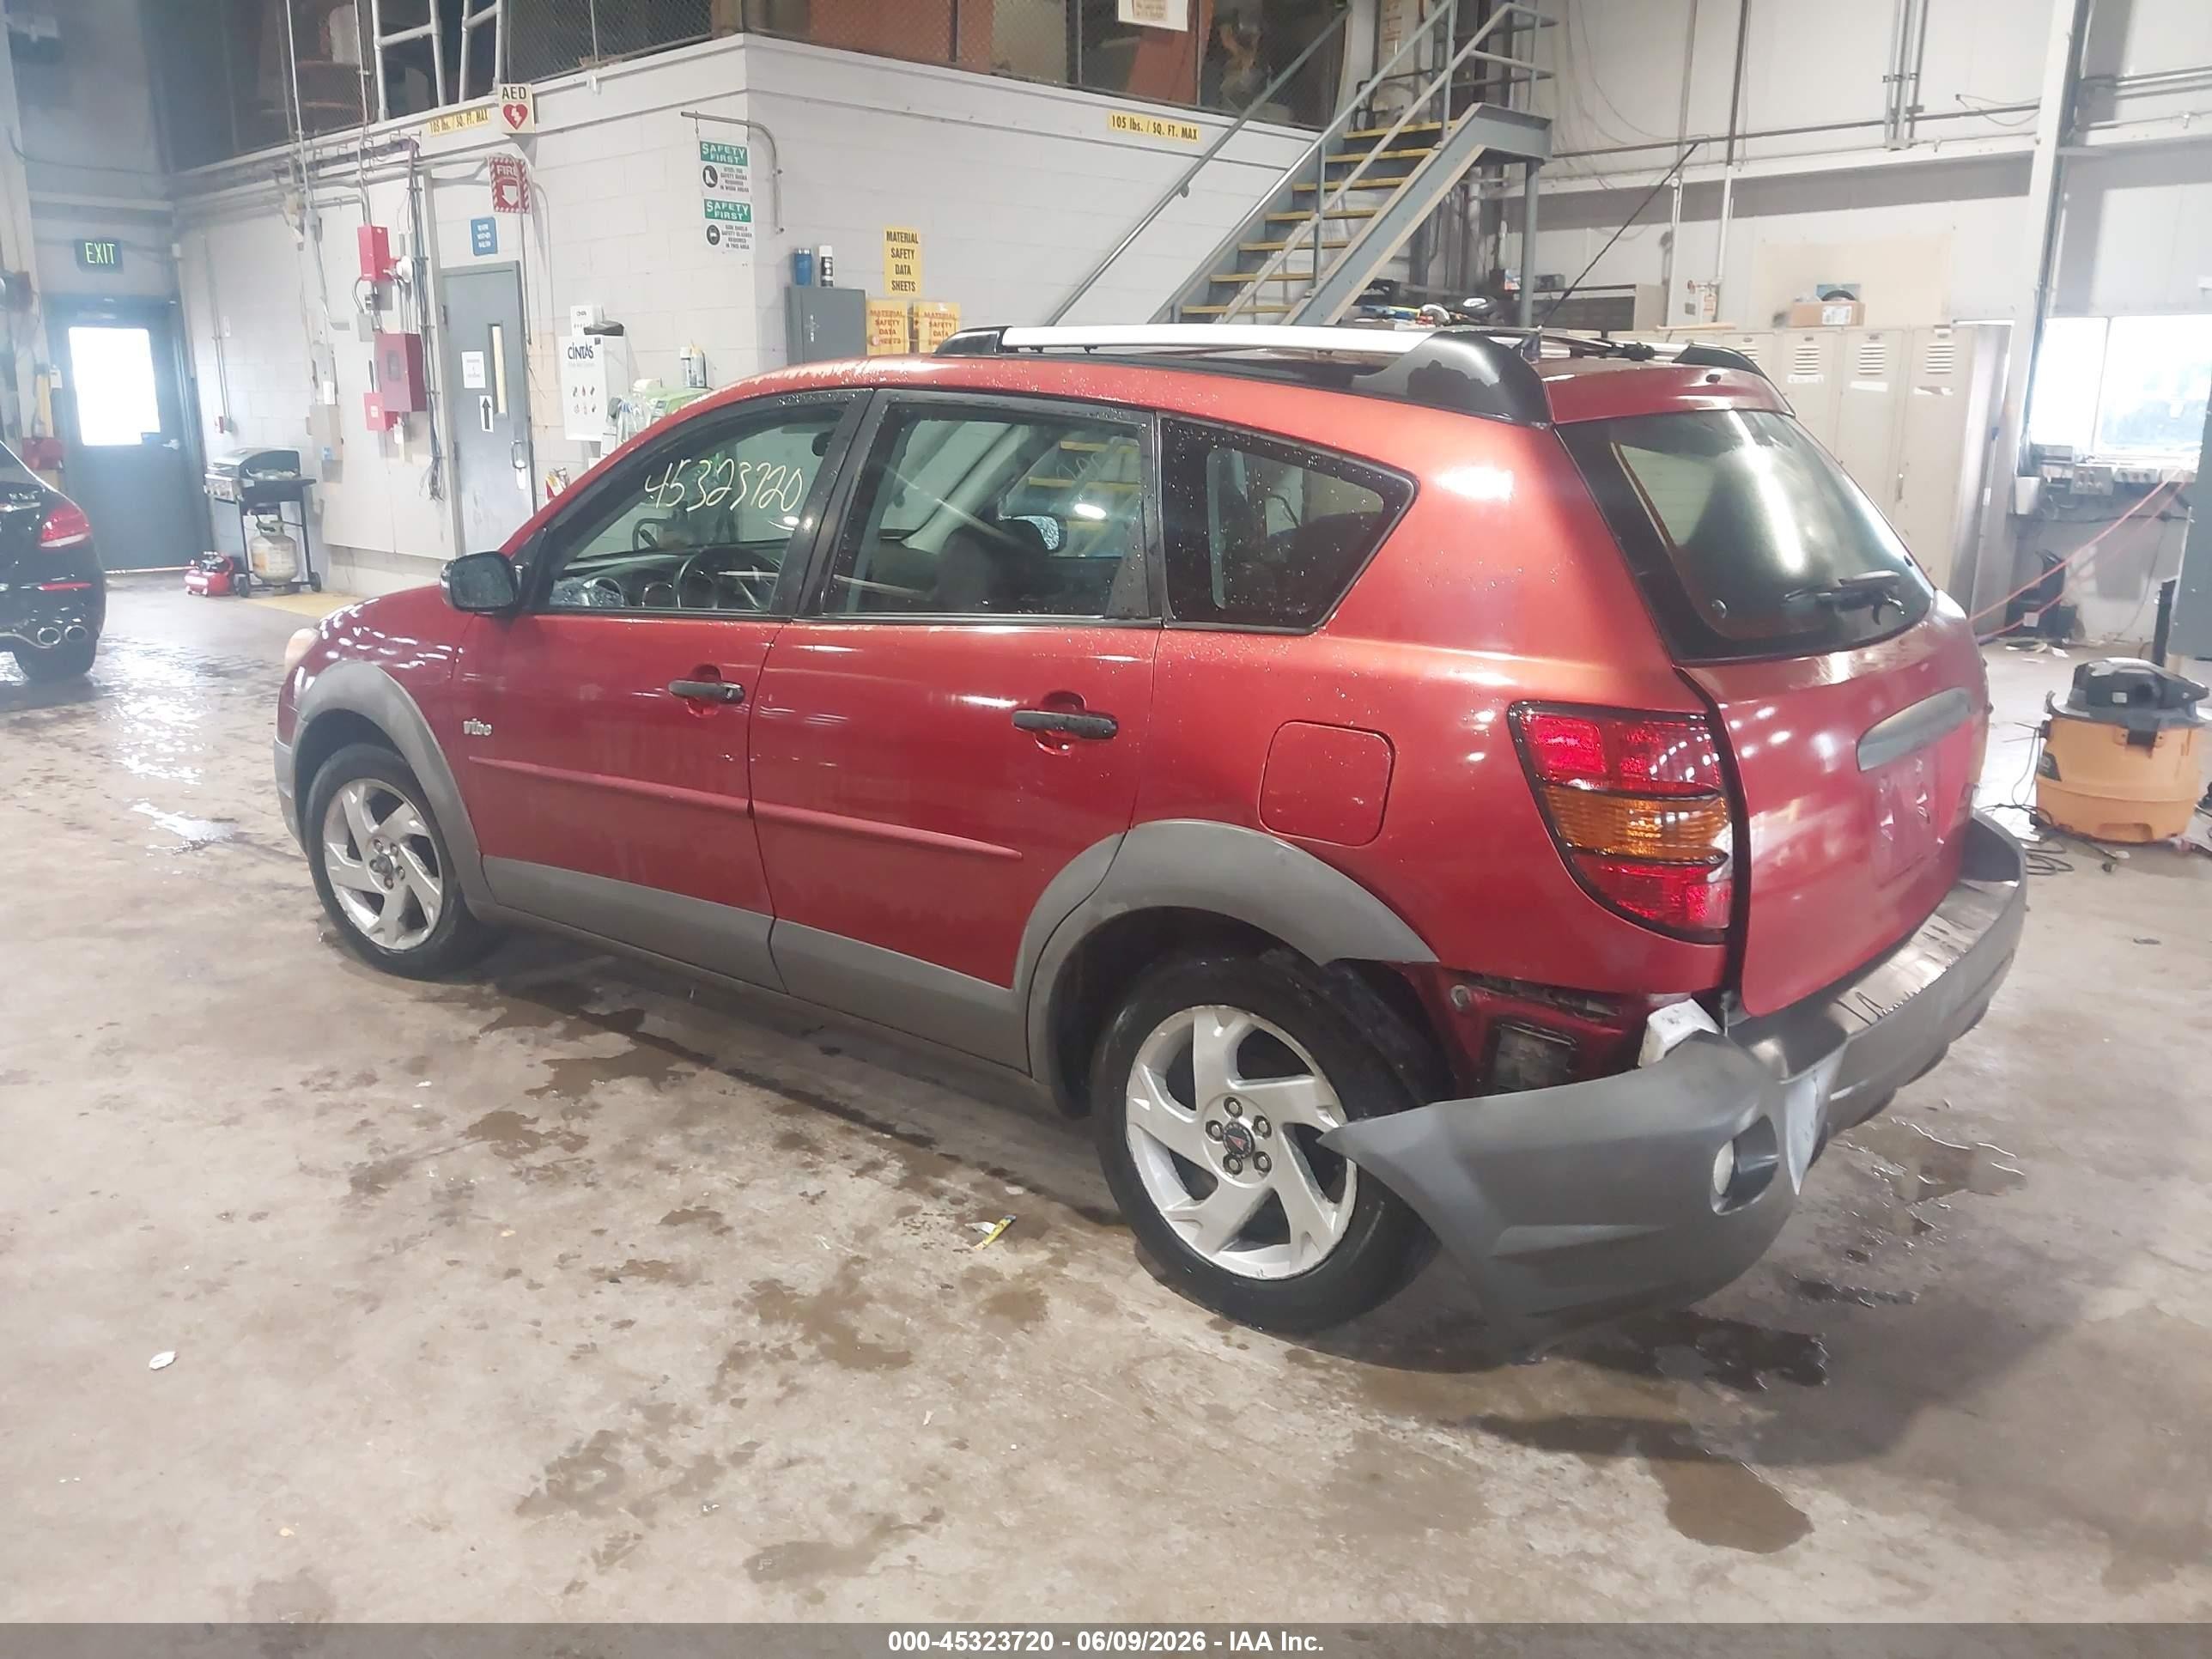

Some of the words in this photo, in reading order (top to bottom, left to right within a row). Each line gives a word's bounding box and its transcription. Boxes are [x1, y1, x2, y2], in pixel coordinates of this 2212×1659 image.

[501, 87, 526, 100] AED
[476, 108, 489, 122] MAX
[1112, 115, 1127, 128] 105
[1129, 117, 1143, 131] lbs.
[1153, 122, 1164, 136] SQ.
[1168, 125, 1178, 137] FT.
[1181, 126, 1198, 140] MAX
[702, 143, 744, 159] SAFETY
[710, 154, 738, 164] FIRST
[707, 201, 749, 216] SAFETY
[714, 210, 743, 220] FIRST
[886, 230, 919, 244] MATERIAL
[85, 242, 116, 264] EXIT
[890, 247, 915, 259] SAFETY
[895, 264, 912, 275] DATA
[891, 280, 916, 292] SHEETS
[644, 458, 803, 513] 45323720
